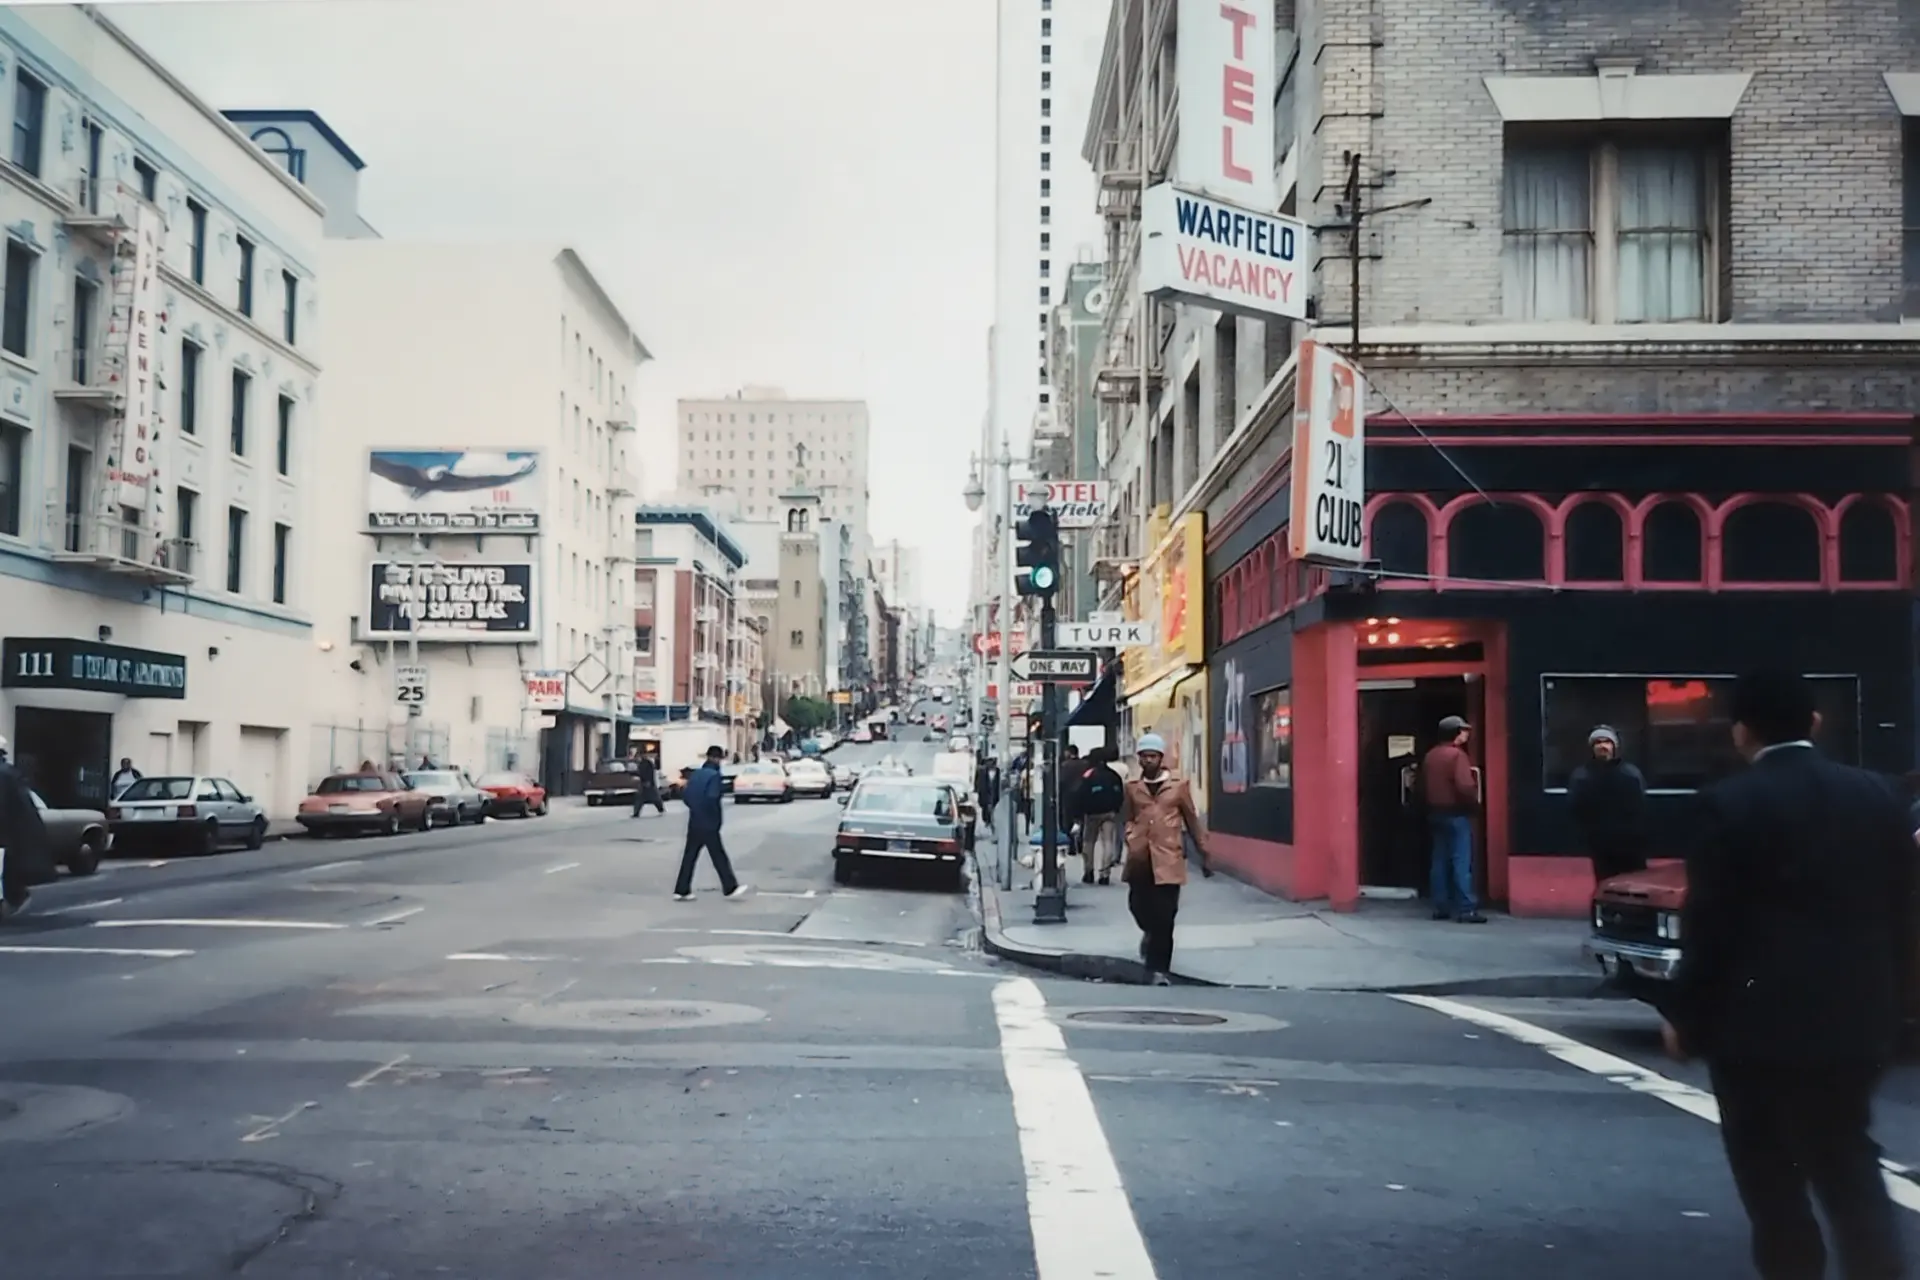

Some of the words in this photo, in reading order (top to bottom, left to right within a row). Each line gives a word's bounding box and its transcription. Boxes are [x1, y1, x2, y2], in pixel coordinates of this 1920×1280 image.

[1220, 0, 1256, 184] TEL
[1176, 197, 1295, 262] WARFIELD
[1178, 243, 1294, 303] VACANCY
[1324, 439, 1342, 489] 21
[1316, 492, 1362, 548] CLUB
[429, 585, 447, 602] TO
[450, 585, 488, 602] READ
[428, 602, 474, 619] SAVED
[1069, 626, 1143, 643] TURK
[17, 652, 55, 677] 111
[1029, 659, 1056, 673] ONE
[1060, 658, 1087, 673] WAY
[397, 685, 424, 702] 25
[527, 680, 565, 697] PARK
[980, 714, 996, 727] 25
